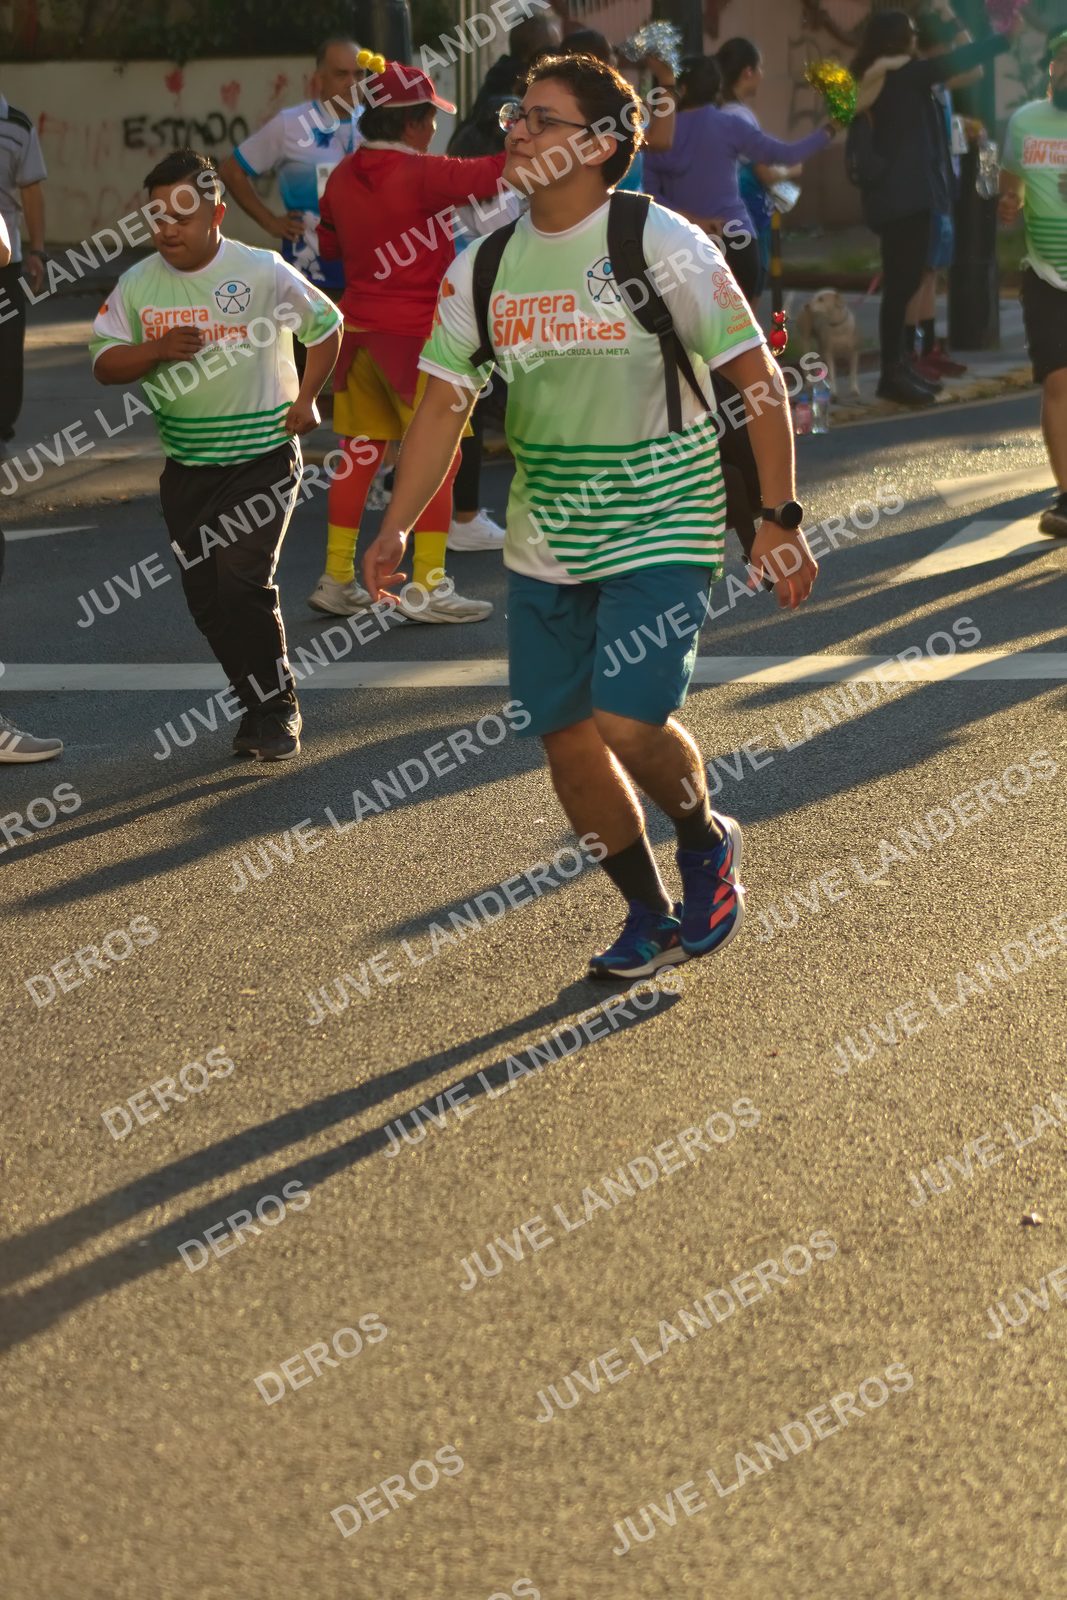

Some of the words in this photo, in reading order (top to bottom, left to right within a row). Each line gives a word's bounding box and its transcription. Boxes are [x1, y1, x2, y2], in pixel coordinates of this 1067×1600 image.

[141, 308, 209, 326] Carrera
[492, 294, 576, 319] Carrera
[492, 317, 536, 347] SIN
[541, 316, 627, 343] límites
[593, 347, 604, 356] LA
[606, 346, 631, 357] META
